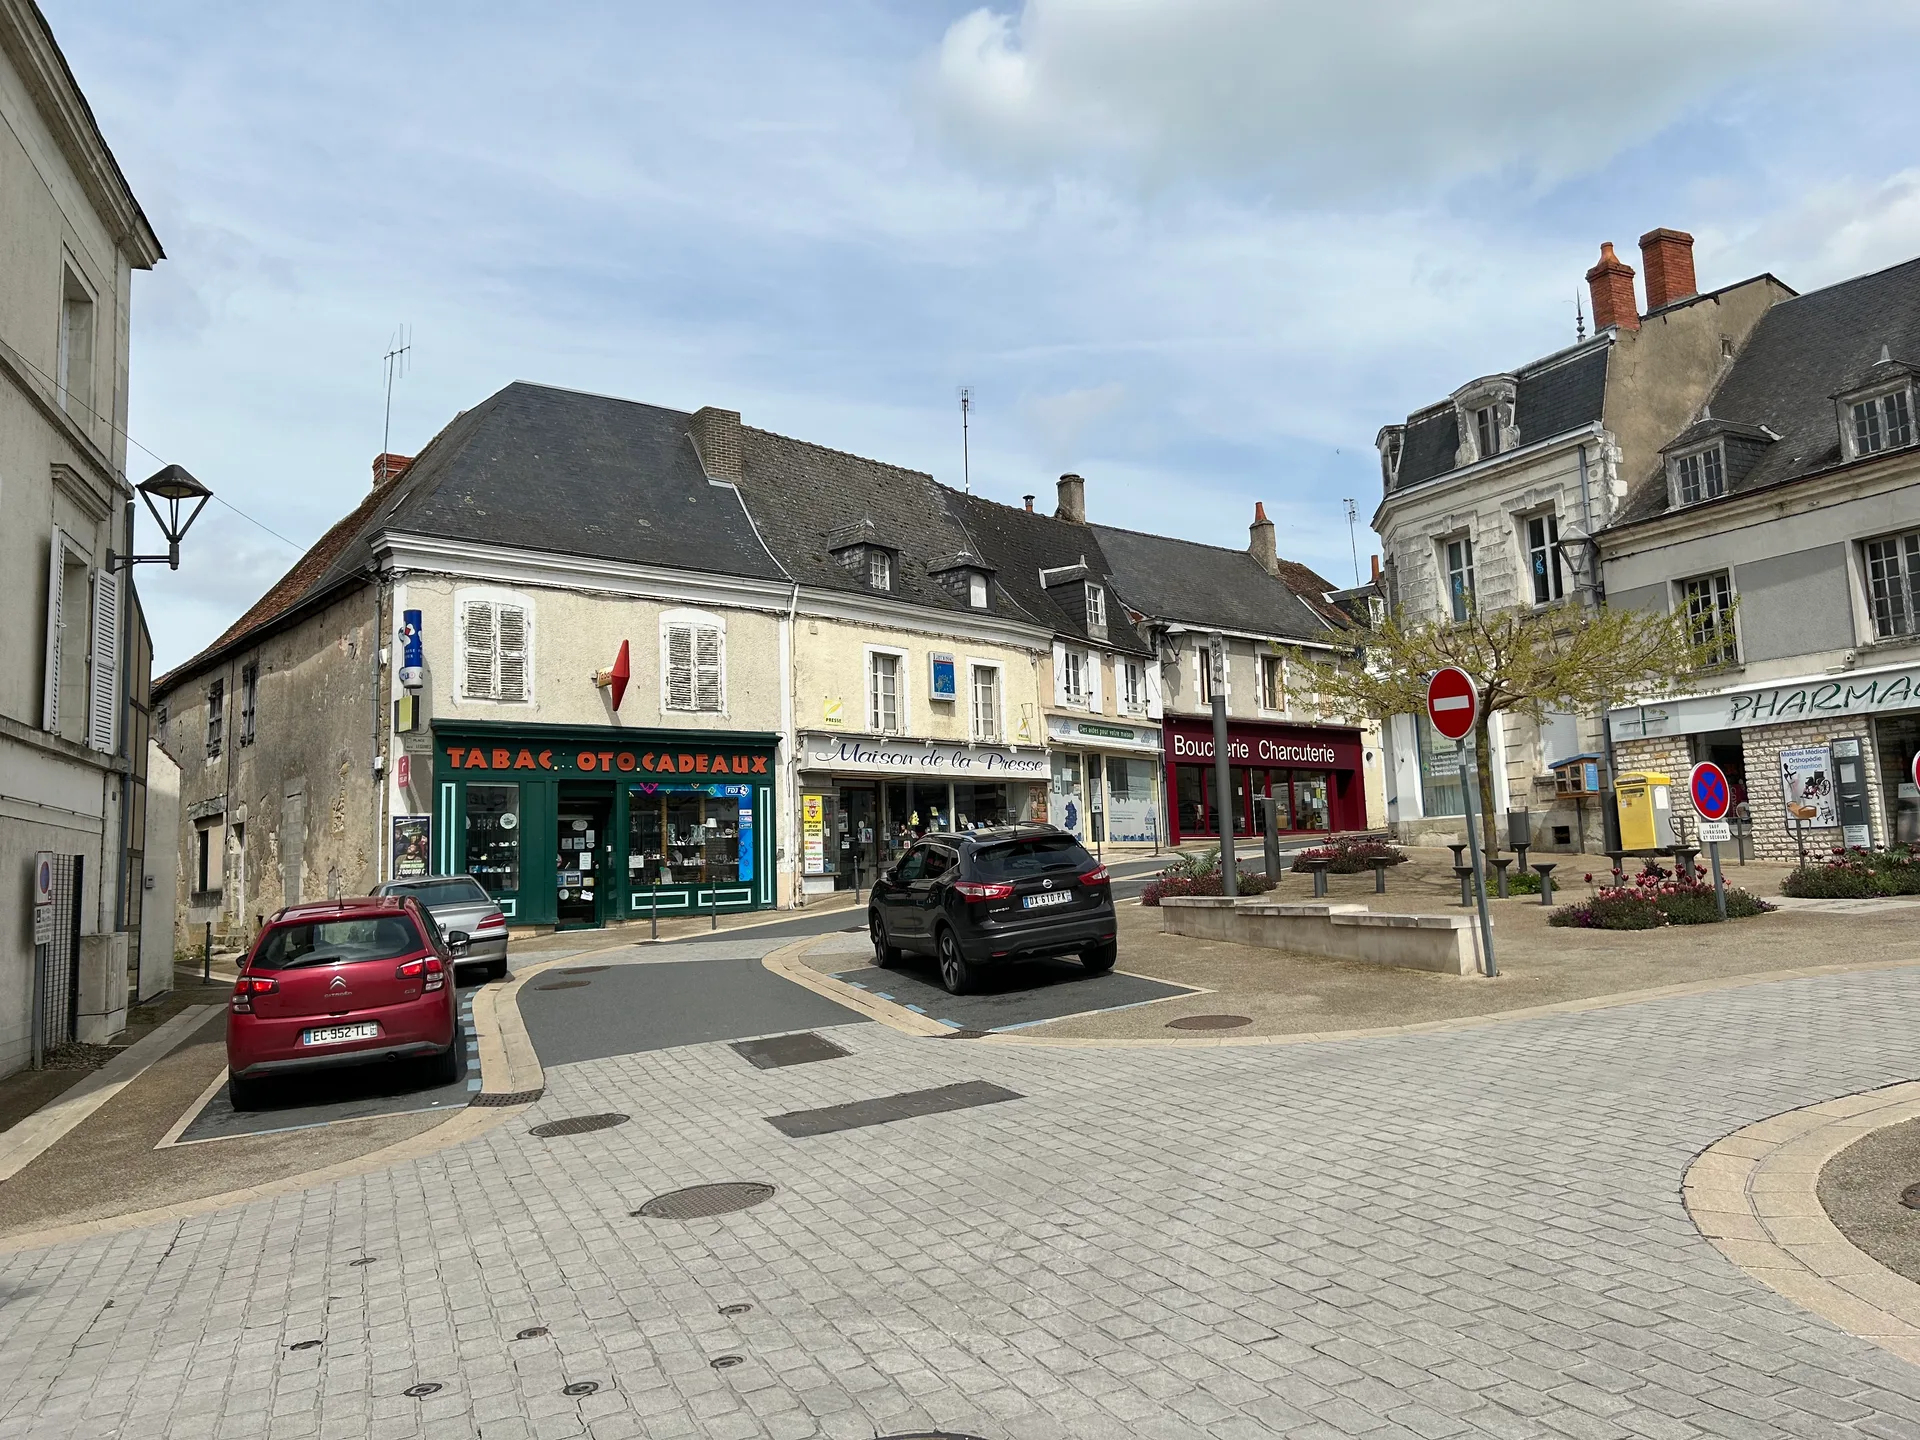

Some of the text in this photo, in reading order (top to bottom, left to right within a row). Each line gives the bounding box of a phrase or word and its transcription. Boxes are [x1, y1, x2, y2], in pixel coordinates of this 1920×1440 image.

[1173, 734, 1335, 763] Boucrie Charcuterie
[1805, 748, 1829, 756] Médical
[815, 743, 1044, 772] Maison de la Presse
[1788, 756, 1822, 764] Orthopédie
[1789, 763, 1823, 771] Contention
[313, 1025, 368, 1042] EC-952-TL
